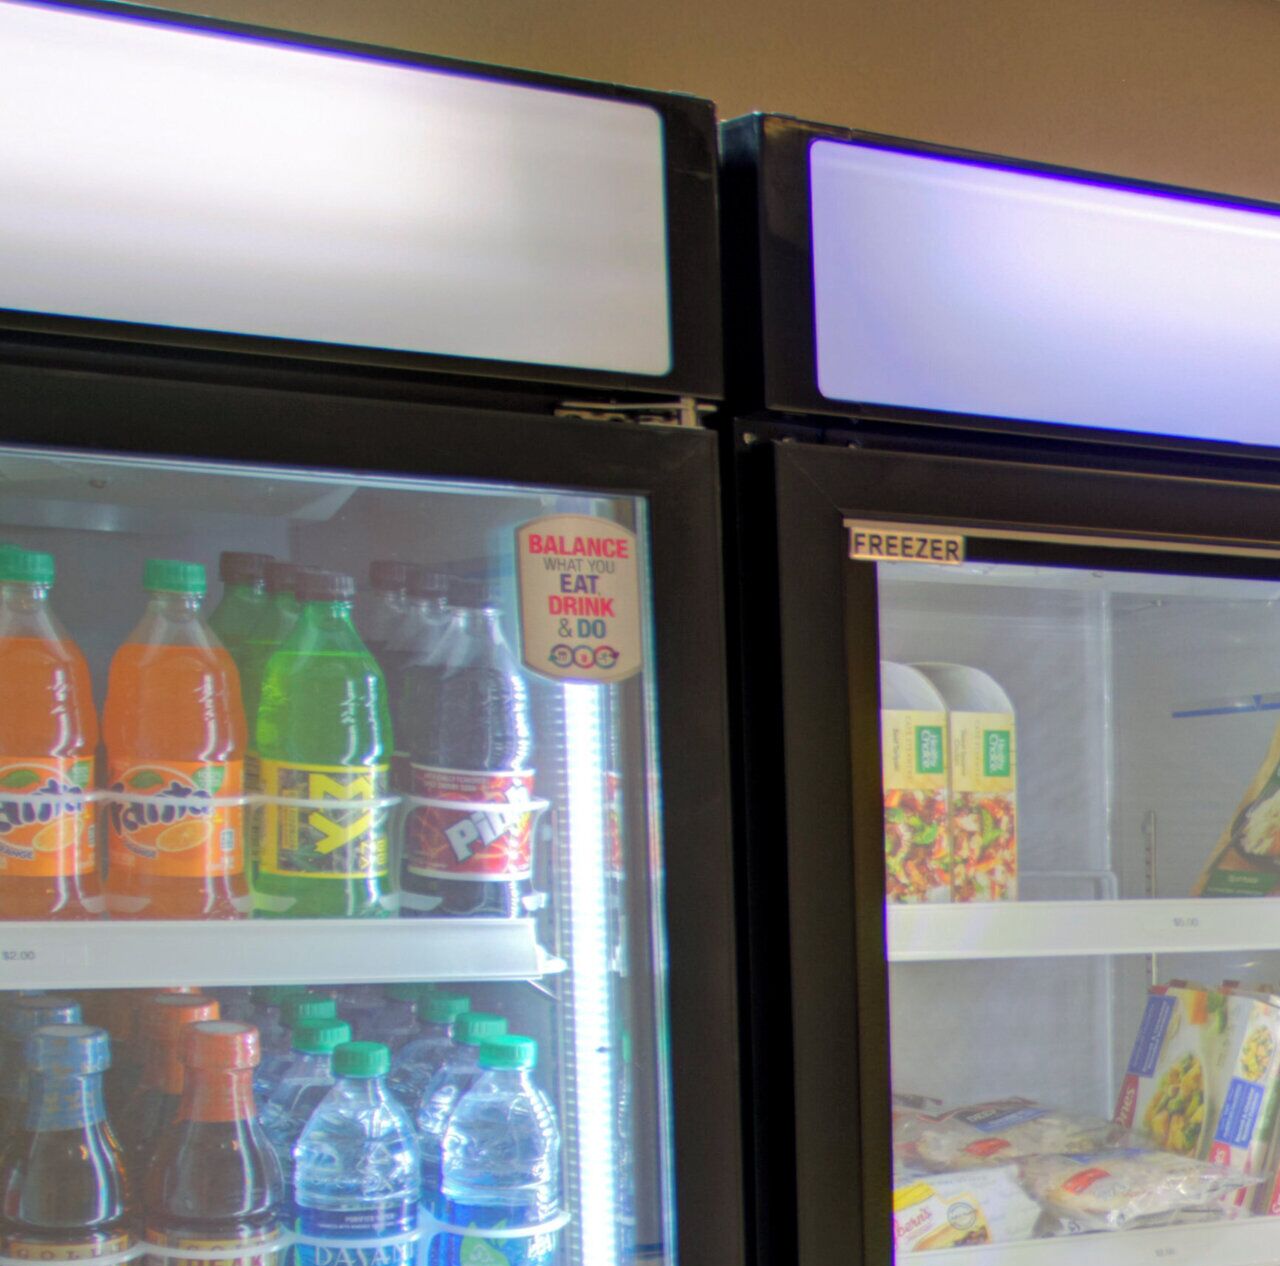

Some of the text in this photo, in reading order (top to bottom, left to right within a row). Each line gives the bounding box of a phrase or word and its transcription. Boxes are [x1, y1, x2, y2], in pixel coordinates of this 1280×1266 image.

[528, 534, 629, 558] BALANCE
[854, 533, 960, 560] FREEZER
[544, 558, 615, 574] WHAT YOU
[548, 595, 616, 617] DRINK
[558, 618, 606, 638] & DO
